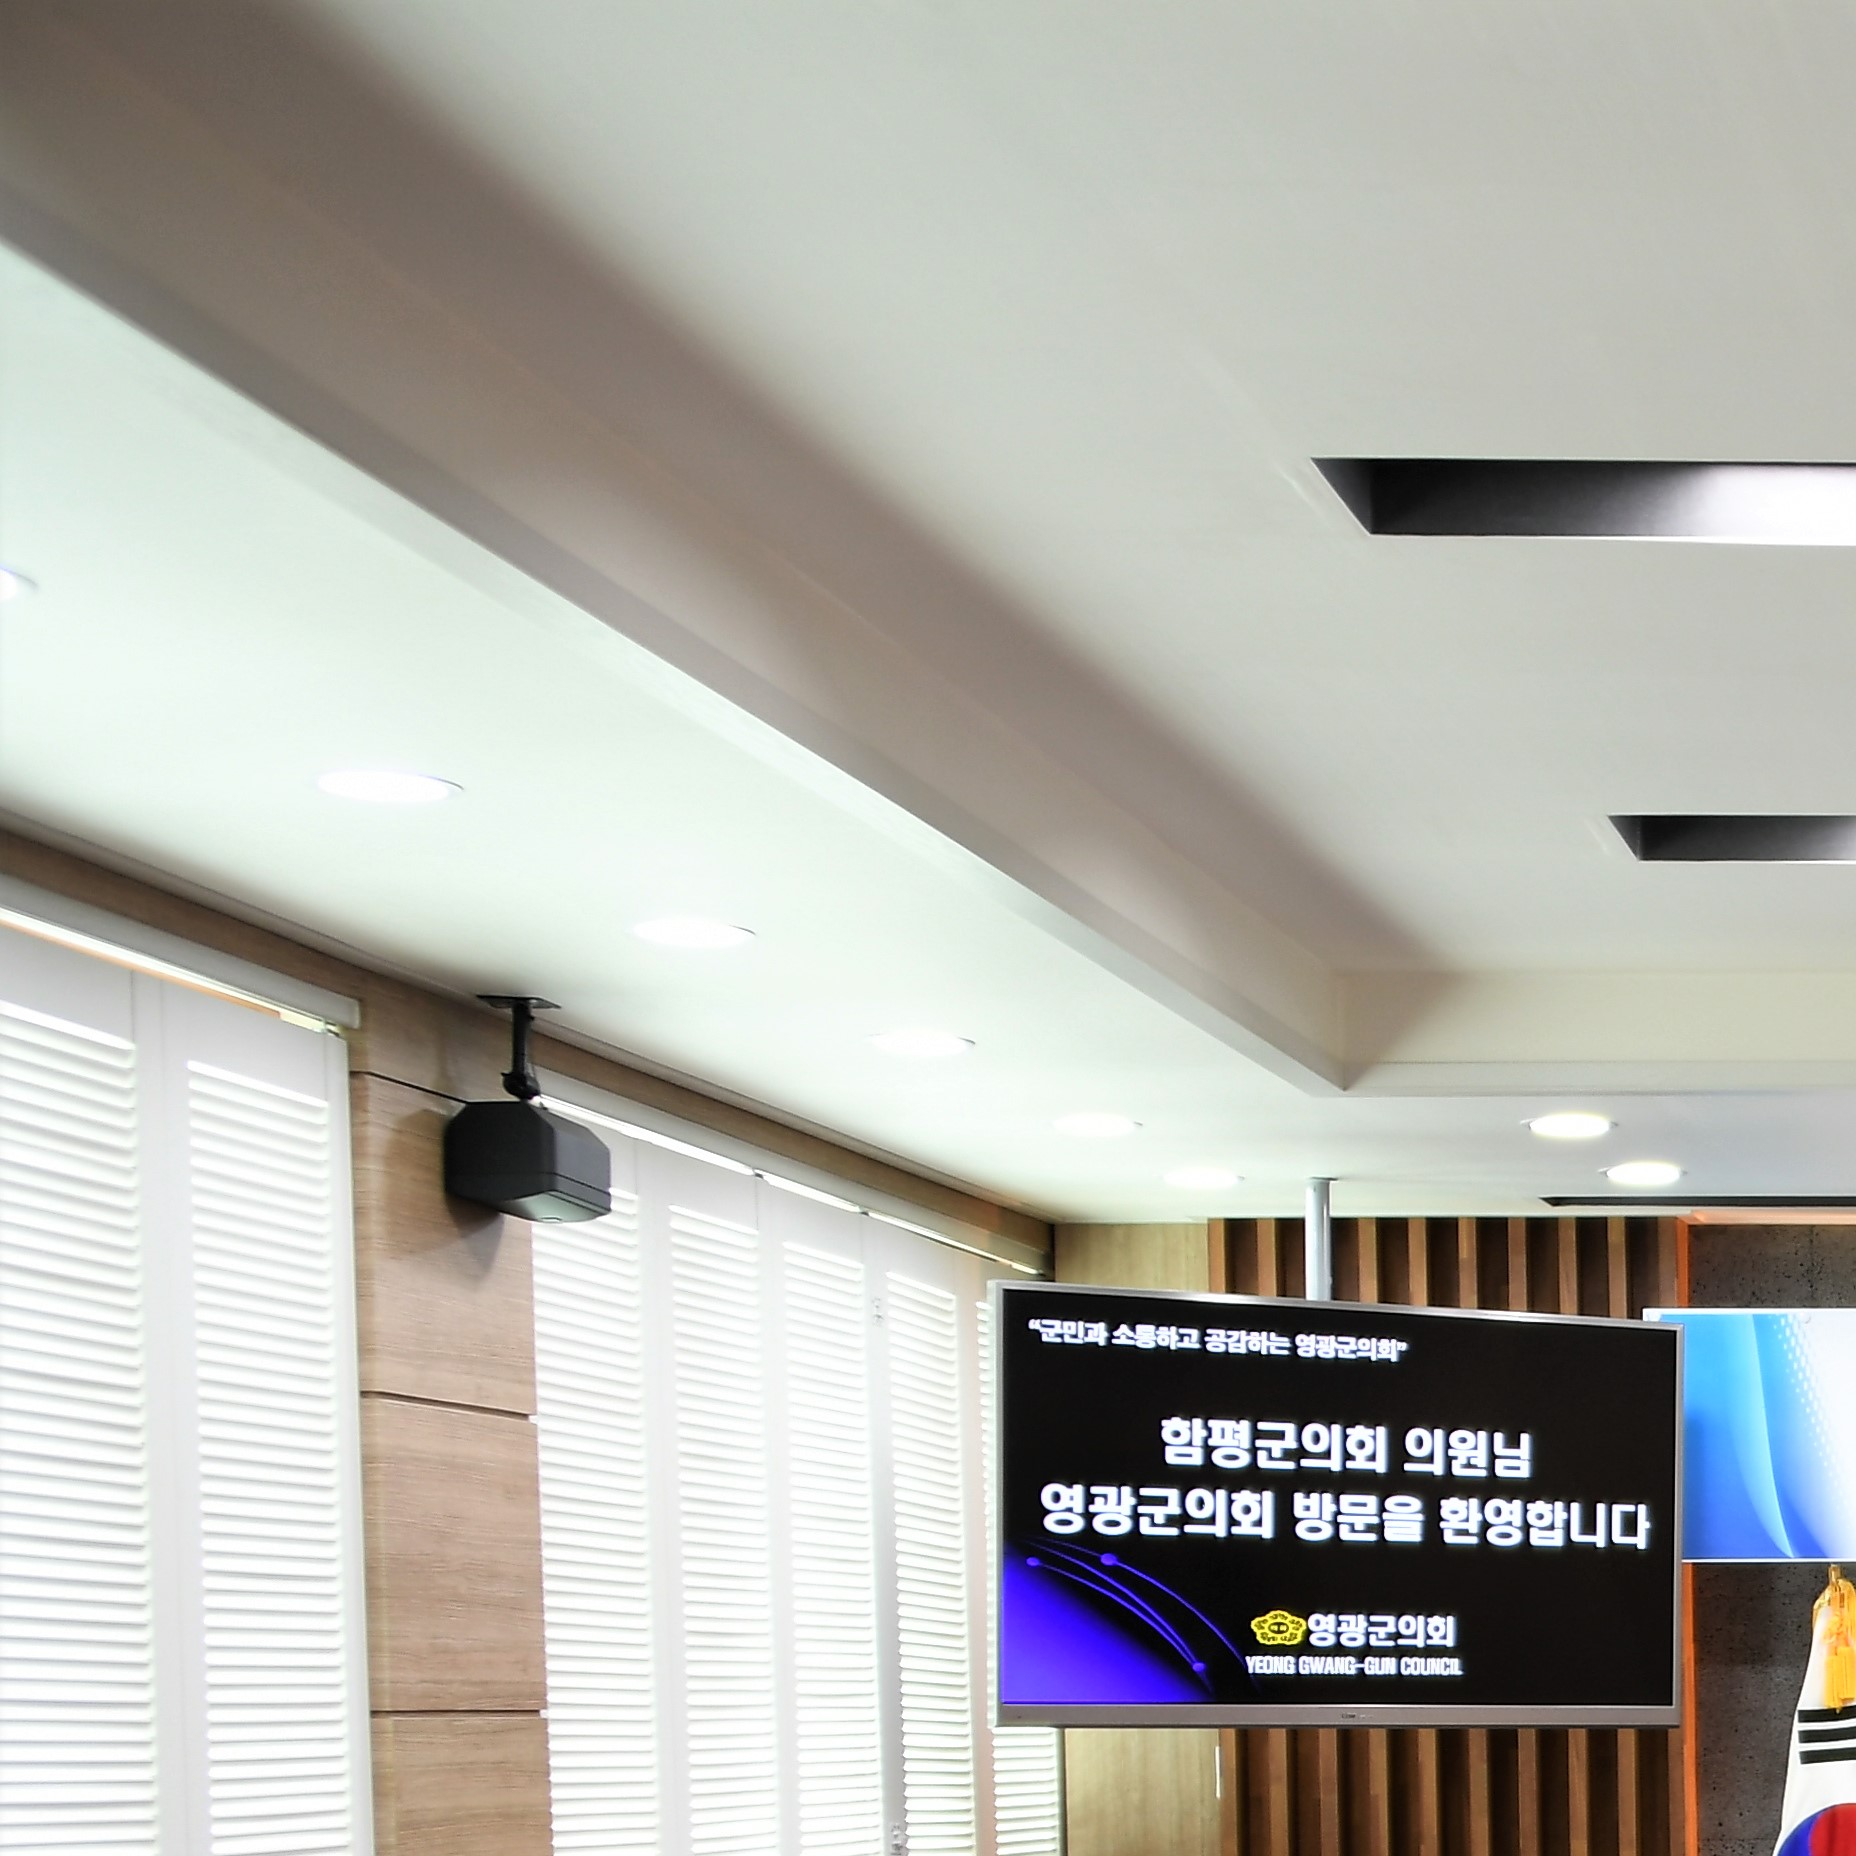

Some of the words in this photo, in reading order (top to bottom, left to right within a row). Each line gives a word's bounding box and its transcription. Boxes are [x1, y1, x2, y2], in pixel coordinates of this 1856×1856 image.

[1112, 1322, 1201, 1351] 소통하고
[1204, 1327, 1293, 1356] 공감하는
[1161, 1416, 1389, 1474] 함평군의회
[1403, 1427, 1532, 1479] 의원님
[1040, 1482, 1275, 1540] 영광군의회
[1293, 1491, 1425, 1543] 방문을
[1439, 1496, 1652, 1550] 환영합니다
[1307, 1613, 1456, 1649] 영광군의회
[1245, 1655, 1297, 1675] YEONG
[1299, 1656, 1398, 1676] GWANG-GUN
[1400, 1657, 1465, 1677] COUNCIL
